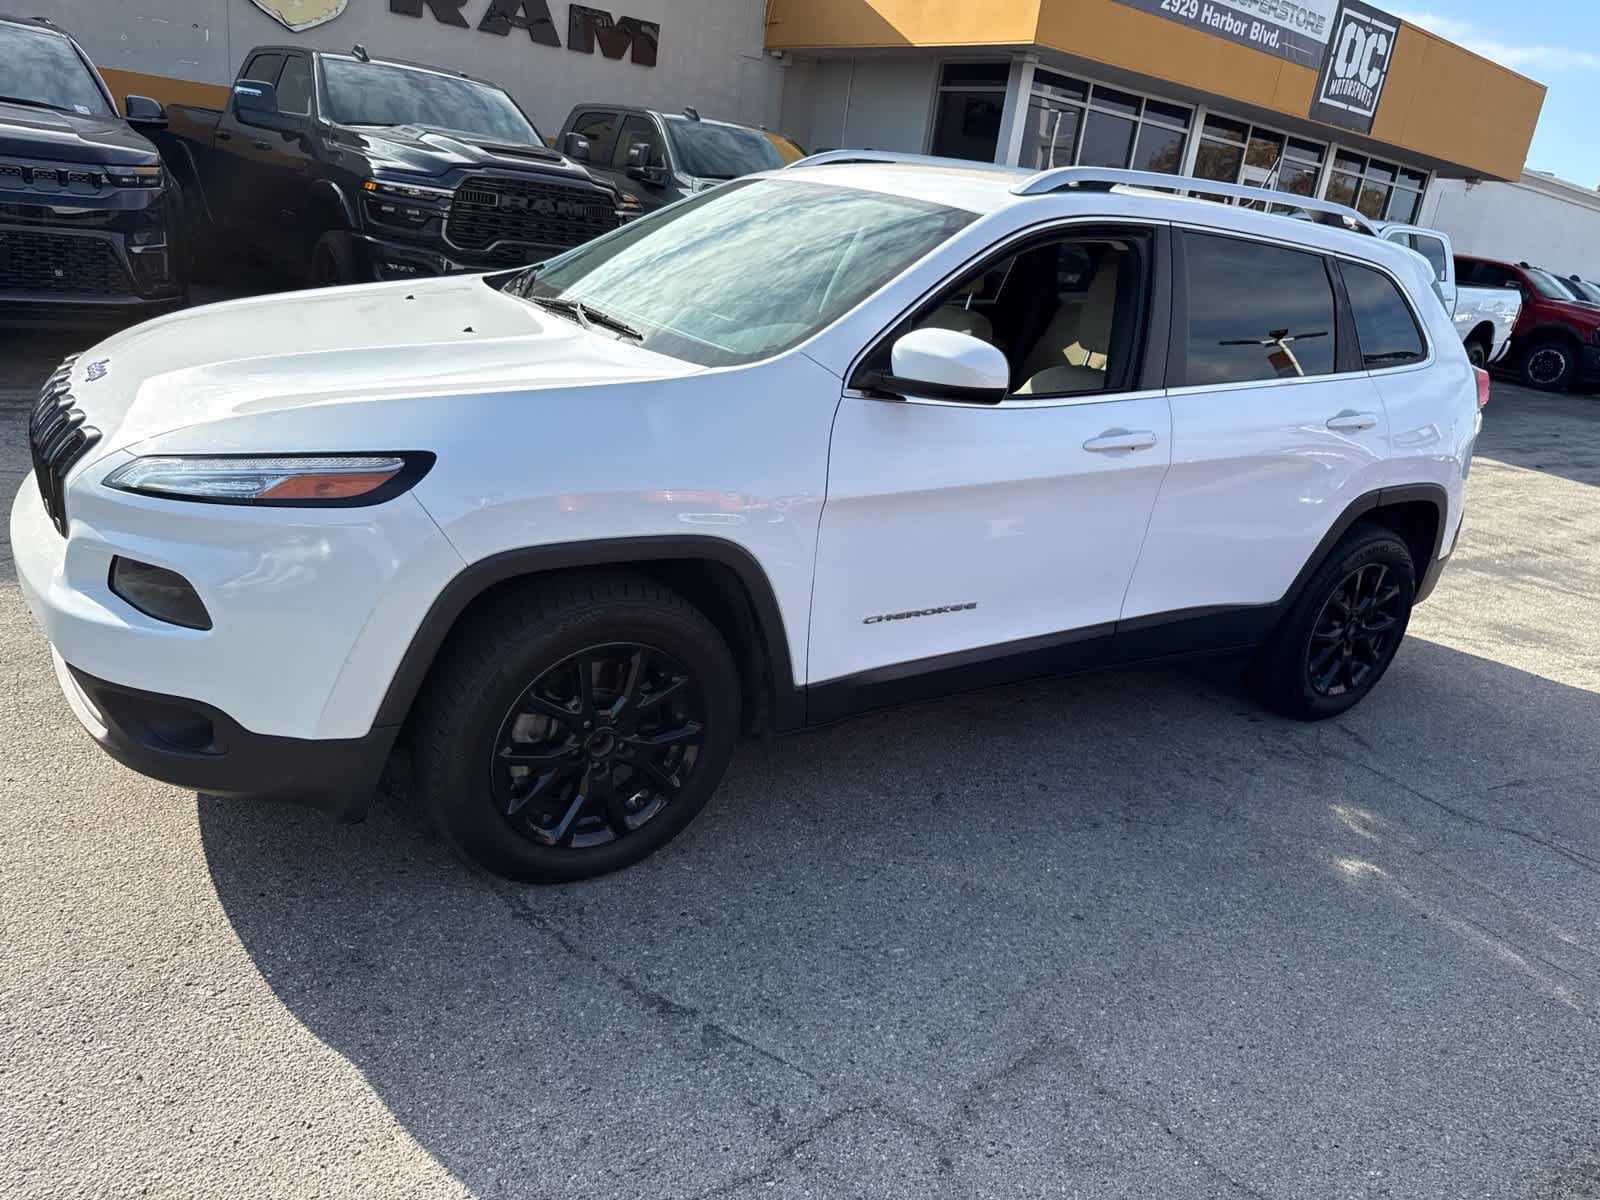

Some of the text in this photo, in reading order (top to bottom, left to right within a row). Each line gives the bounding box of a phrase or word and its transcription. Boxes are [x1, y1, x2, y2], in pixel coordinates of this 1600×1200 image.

[1200, 3, 1248, 36] Harbor
[1249, 21, 1280, 48] Blvd.
[1334, 21, 1388, 89] OC
[1328, 78, 1373, 108] MOTORSPORTS
[501, 193, 585, 217] RAM
[863, 602, 978, 624] CHEROKEE
